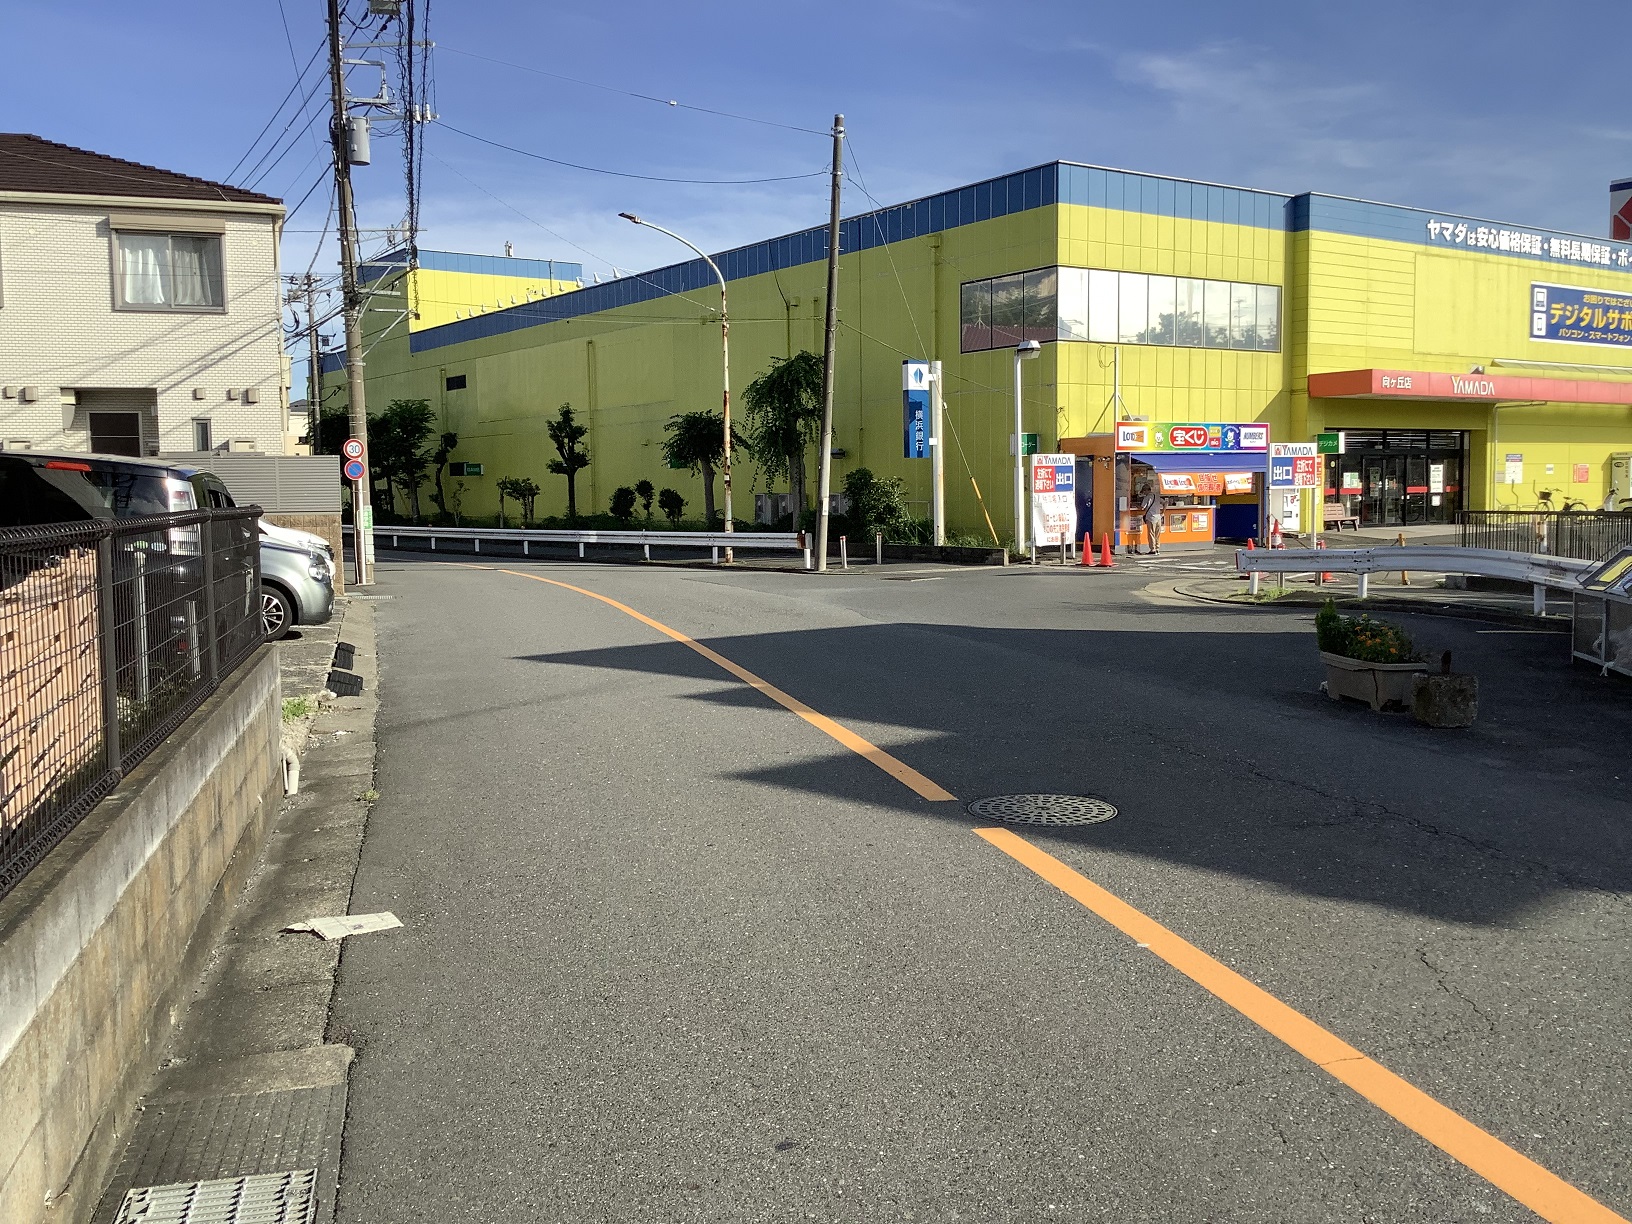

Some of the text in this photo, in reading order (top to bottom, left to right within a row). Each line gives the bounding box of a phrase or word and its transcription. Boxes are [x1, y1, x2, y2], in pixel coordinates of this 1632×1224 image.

[1427, 218, 1632, 267] ヤマダは安心価格保証・無料長期保証・ポ
[1451, 375, 1495, 396] YAMADA
[914, 409, 924, 452] 横浜銀行
[1173, 429, 1204, 445] 宝くじ
[348, 444, 360, 454] 30
[1282, 444, 1313, 456] YAMADA
[1044, 455, 1071, 465] YAMADA
[1055, 472, 1073, 486] 出口
[1273, 465, 1293, 481] 出口
